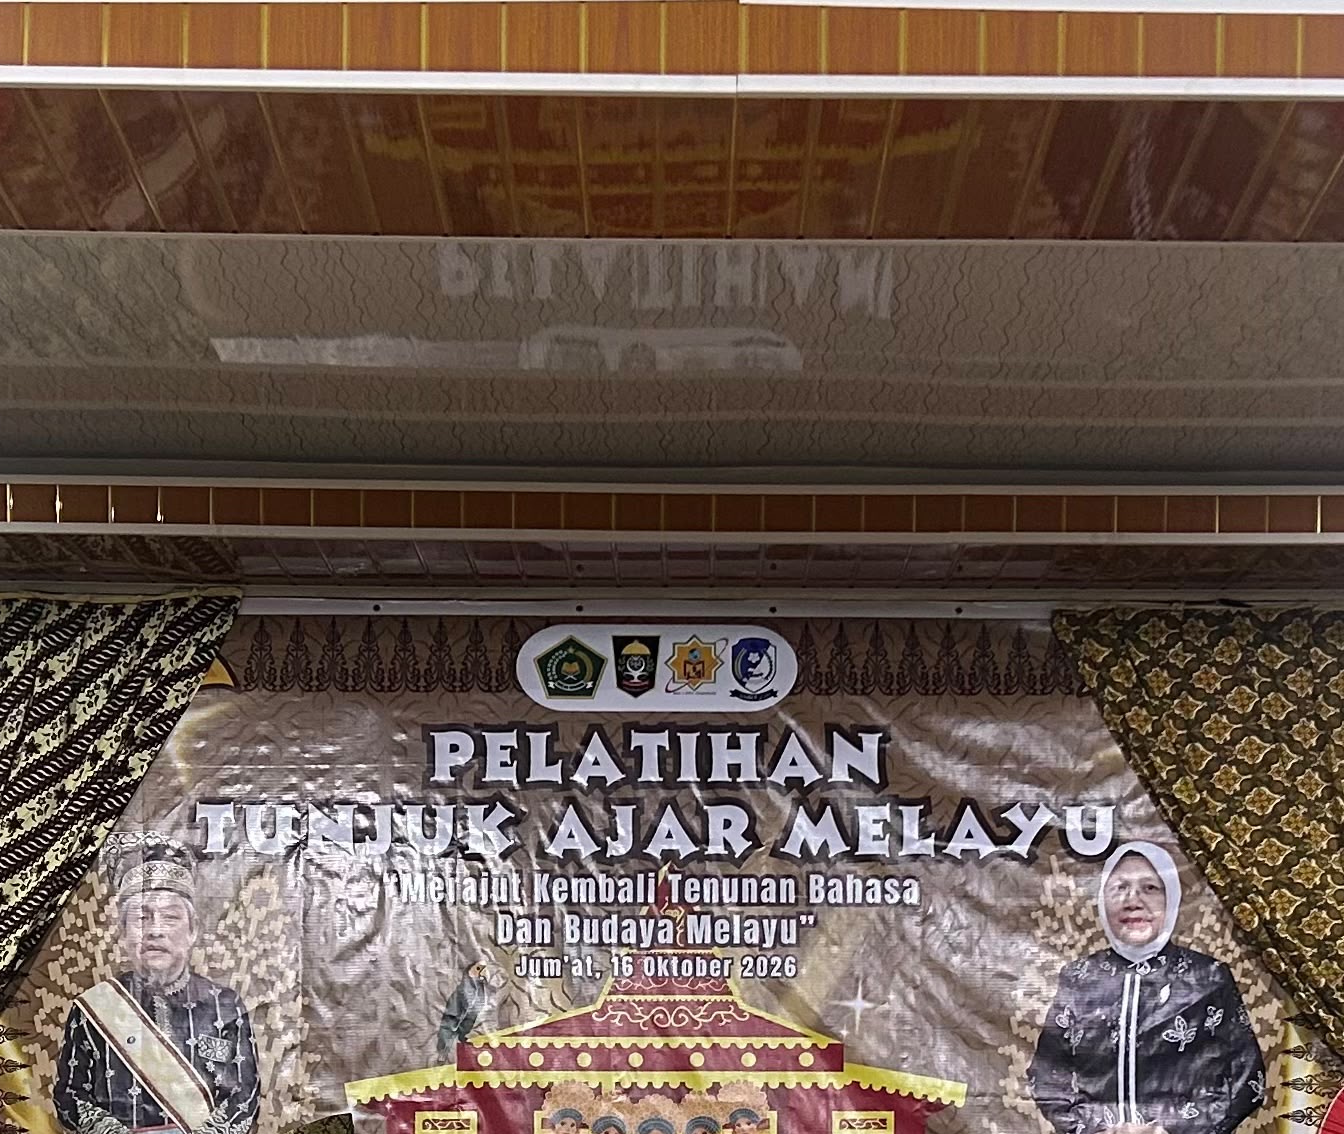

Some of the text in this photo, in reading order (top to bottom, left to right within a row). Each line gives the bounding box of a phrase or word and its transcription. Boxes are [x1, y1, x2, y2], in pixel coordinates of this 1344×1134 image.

[427, 728, 885, 788] PELATIHAN
[194, 799, 1118, 859] TUNJUK AJAR MELAYU
[536, 871, 655, 905] Kembali
[667, 872, 797, 905] Tenunan
[808, 872, 921, 905] Bahasa
[497, 913, 552, 945] Dan
[565, 913, 676, 949] Budaya
[610, 957, 635, 978] 16
[643, 956, 733, 978] Oktober
[741, 956, 797, 978] 2026
